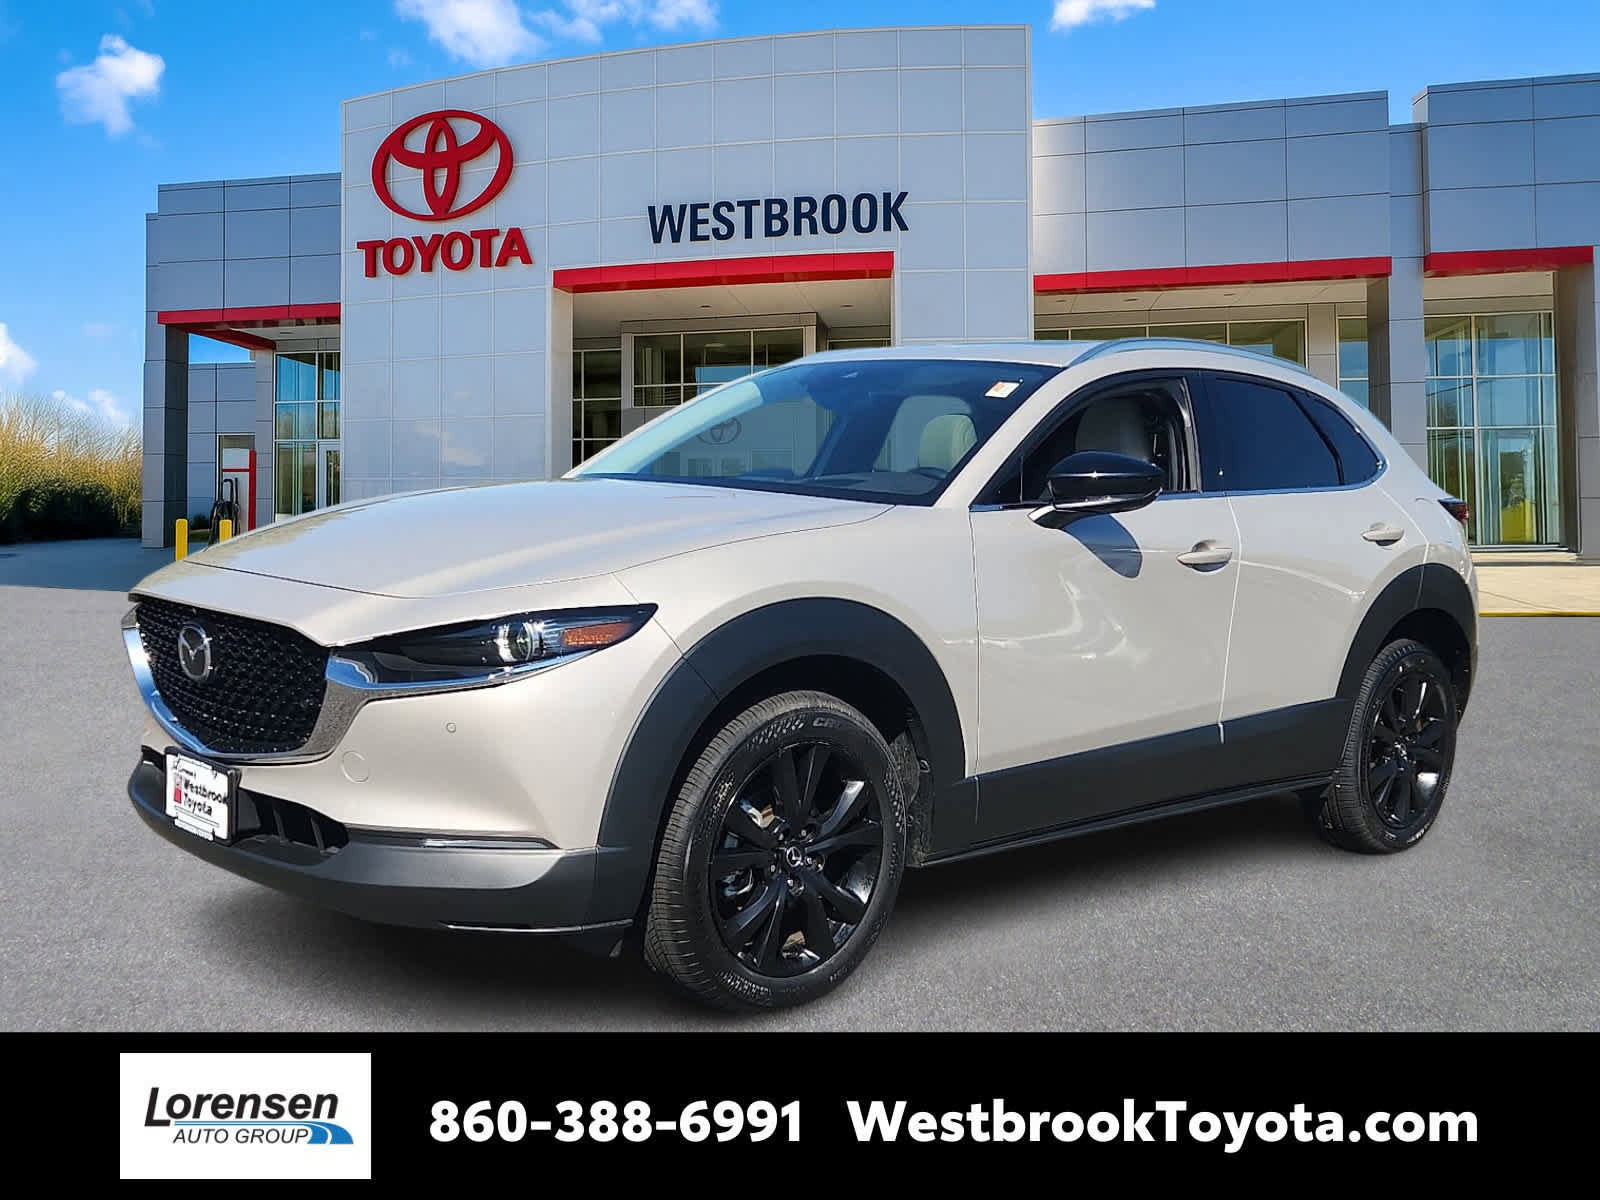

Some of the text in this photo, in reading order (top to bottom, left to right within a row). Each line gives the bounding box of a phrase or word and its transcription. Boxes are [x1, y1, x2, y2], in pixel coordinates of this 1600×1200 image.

[648, 191, 909, 244] WESTBROOK
[357, 227, 532, 277] TOYOTA
[184, 778, 227, 804] Westbrook
[184, 793, 213, 816] Toyota
